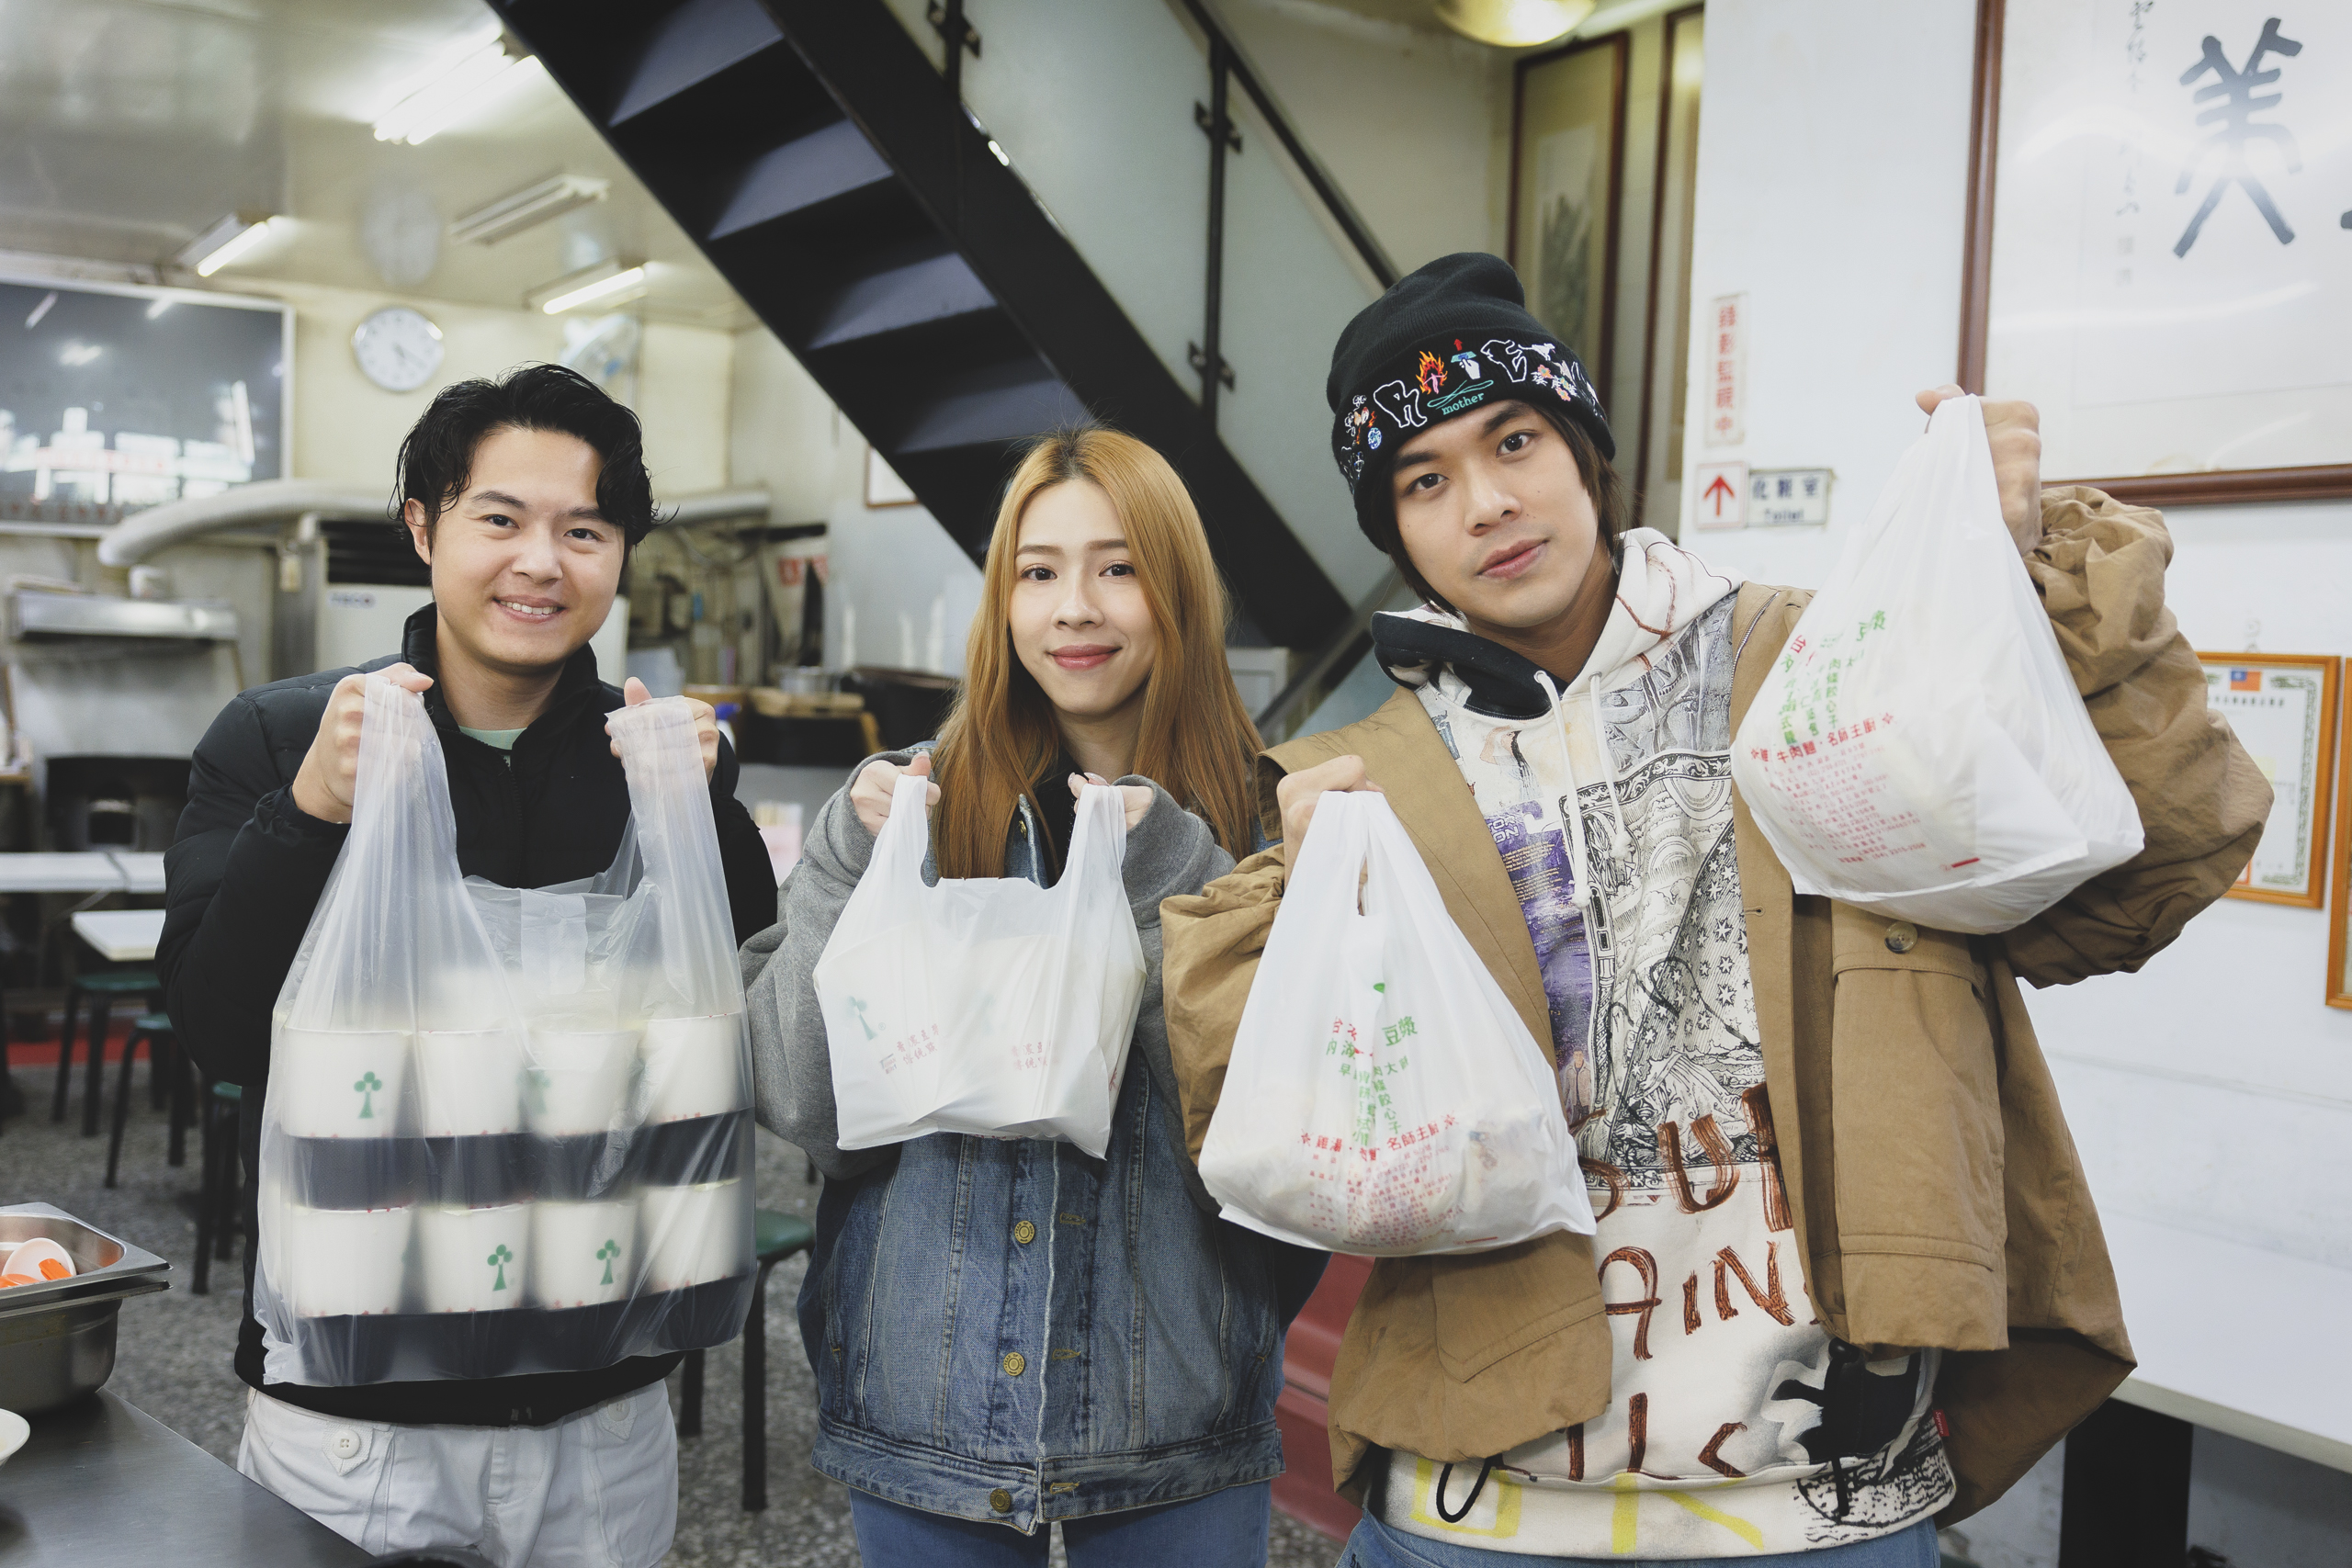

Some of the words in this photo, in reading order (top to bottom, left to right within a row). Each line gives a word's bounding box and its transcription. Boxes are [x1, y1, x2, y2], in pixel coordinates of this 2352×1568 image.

[1442, 392, 1485, 415] mother
[1381, 1015, 1419, 1048] 豆漿
[1386, 1122, 1440, 1152] 名師主廚
